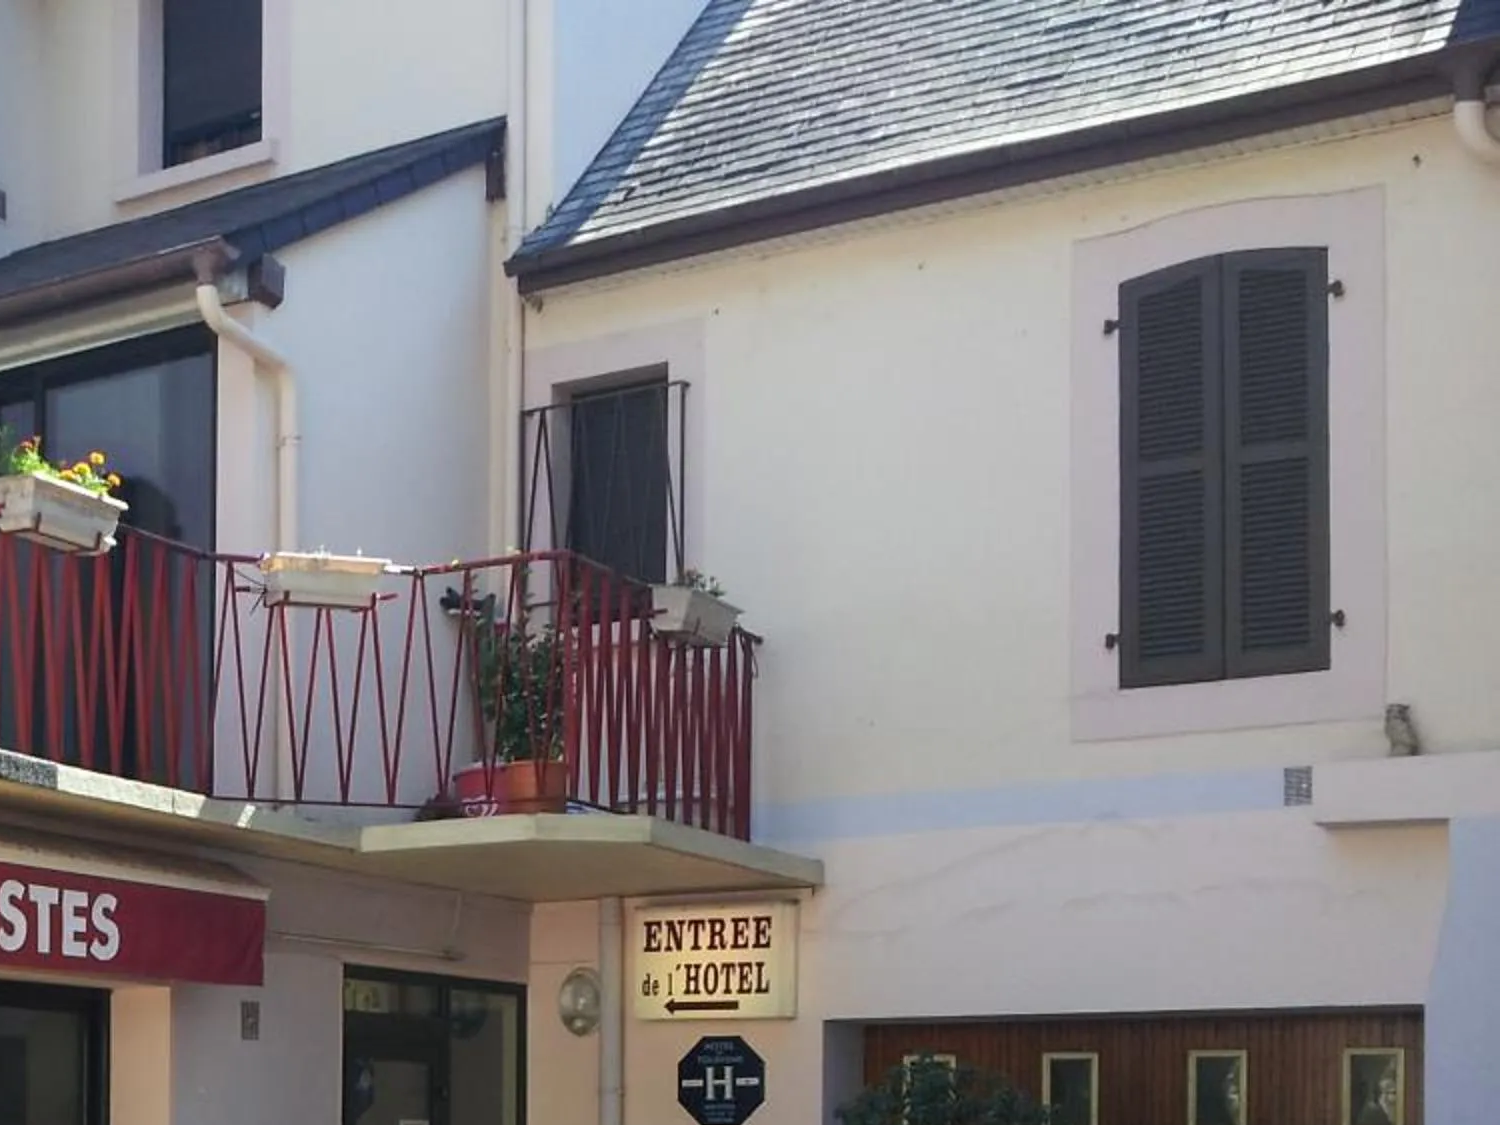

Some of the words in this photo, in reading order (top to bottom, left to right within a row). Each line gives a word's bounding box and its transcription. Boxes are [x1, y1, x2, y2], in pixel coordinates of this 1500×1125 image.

[643, 916, 772, 952] ENTREE
[641, 973, 660, 996] de
[705, 1065, 734, 1101] H
